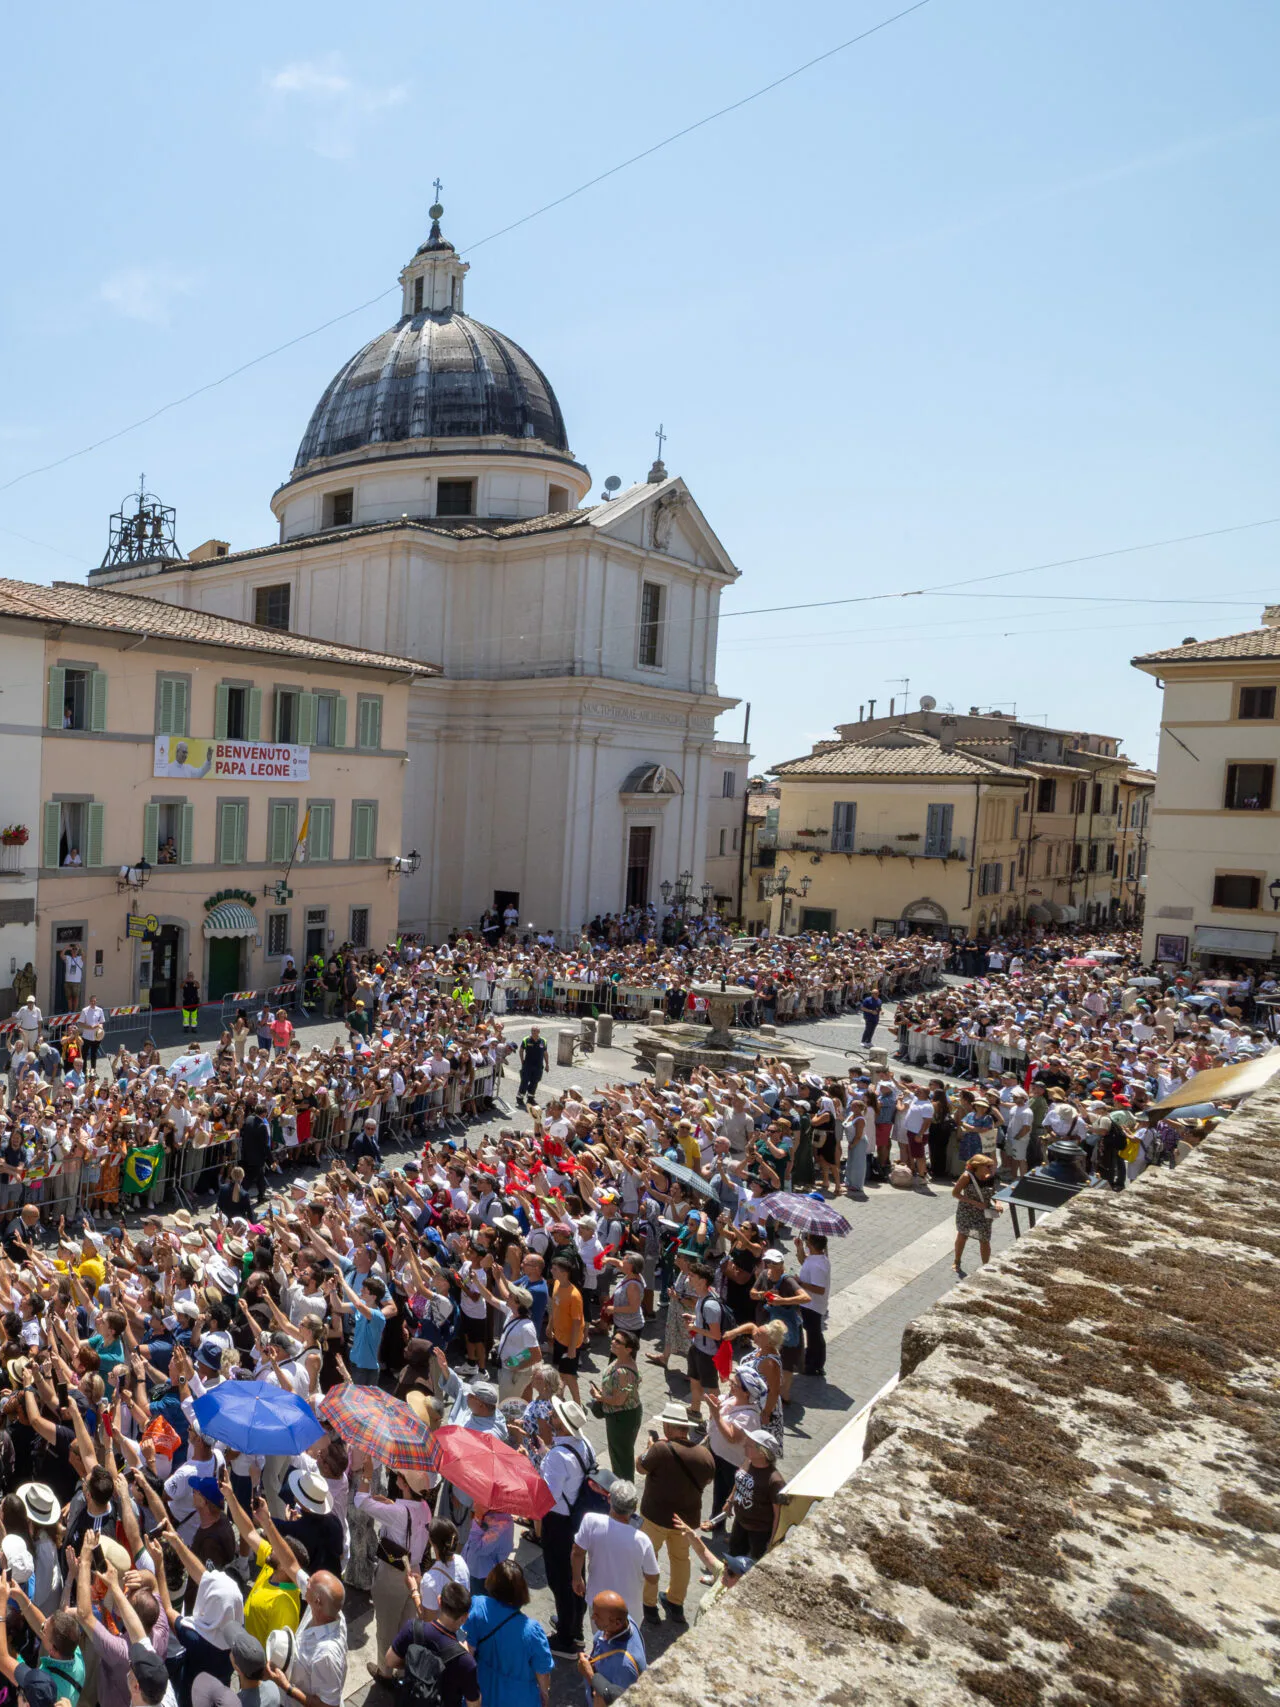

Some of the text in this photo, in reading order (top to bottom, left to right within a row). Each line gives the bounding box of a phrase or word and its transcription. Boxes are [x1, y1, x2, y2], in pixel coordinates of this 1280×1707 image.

[216, 745, 291, 761] BENVENUTO
[215, 761, 247, 775] PAPA
[251, 763, 290, 777] LEONE
